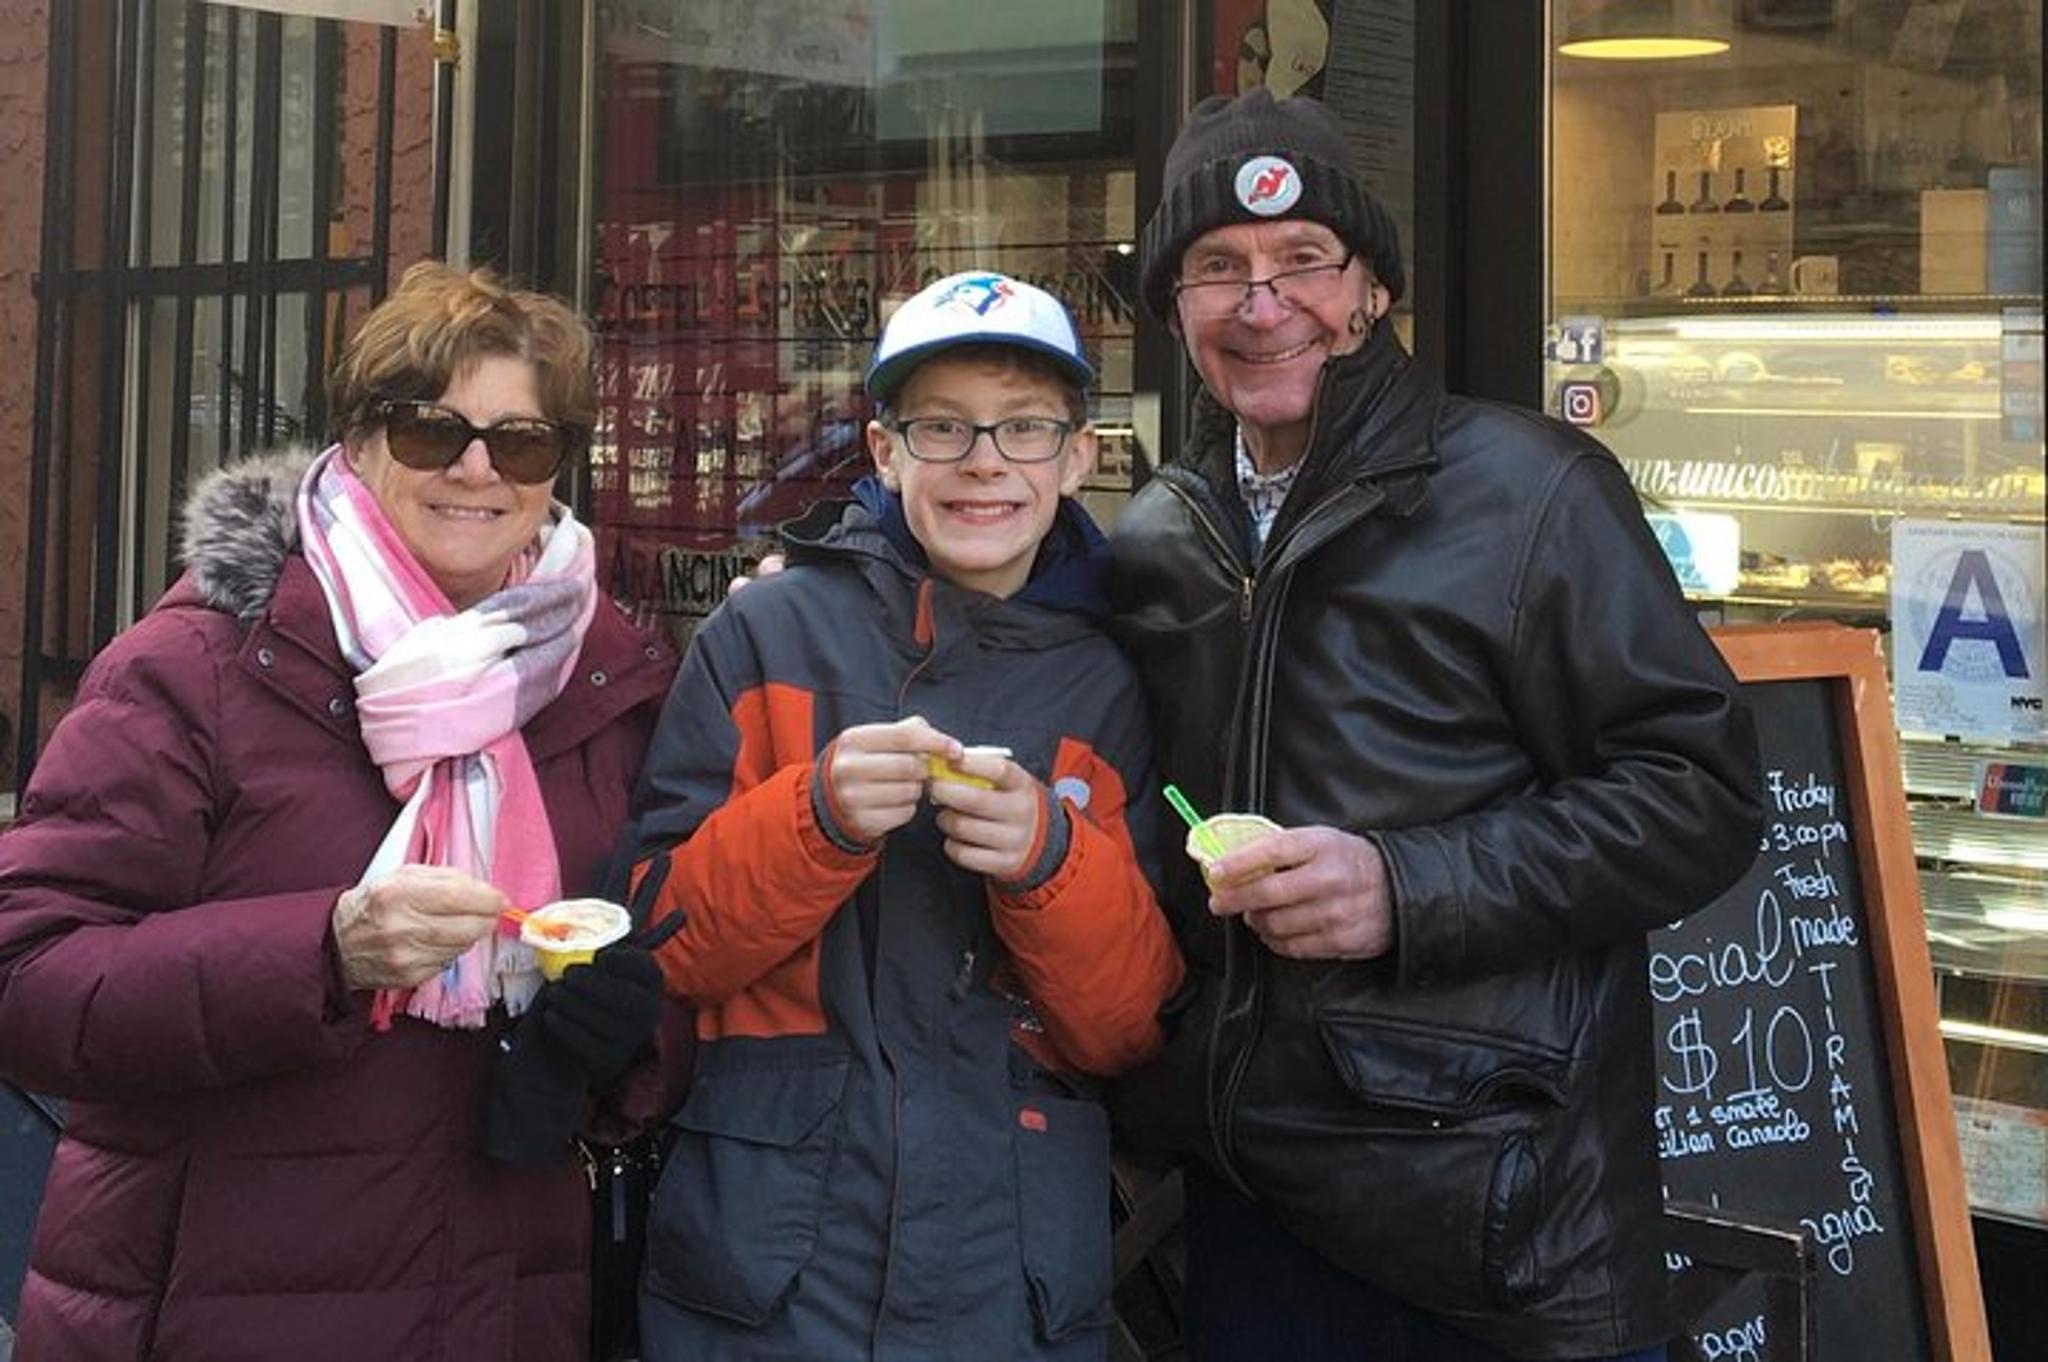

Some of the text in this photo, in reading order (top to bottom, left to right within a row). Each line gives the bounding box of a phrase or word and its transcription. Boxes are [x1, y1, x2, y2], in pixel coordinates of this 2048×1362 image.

[1917, 550, 2030, 679] A
[2010, 695, 2043, 711] NYC
[1767, 770, 1835, 818] Friday
[1789, 903, 1859, 957] made
[1663, 1006, 1813, 1101] $10
